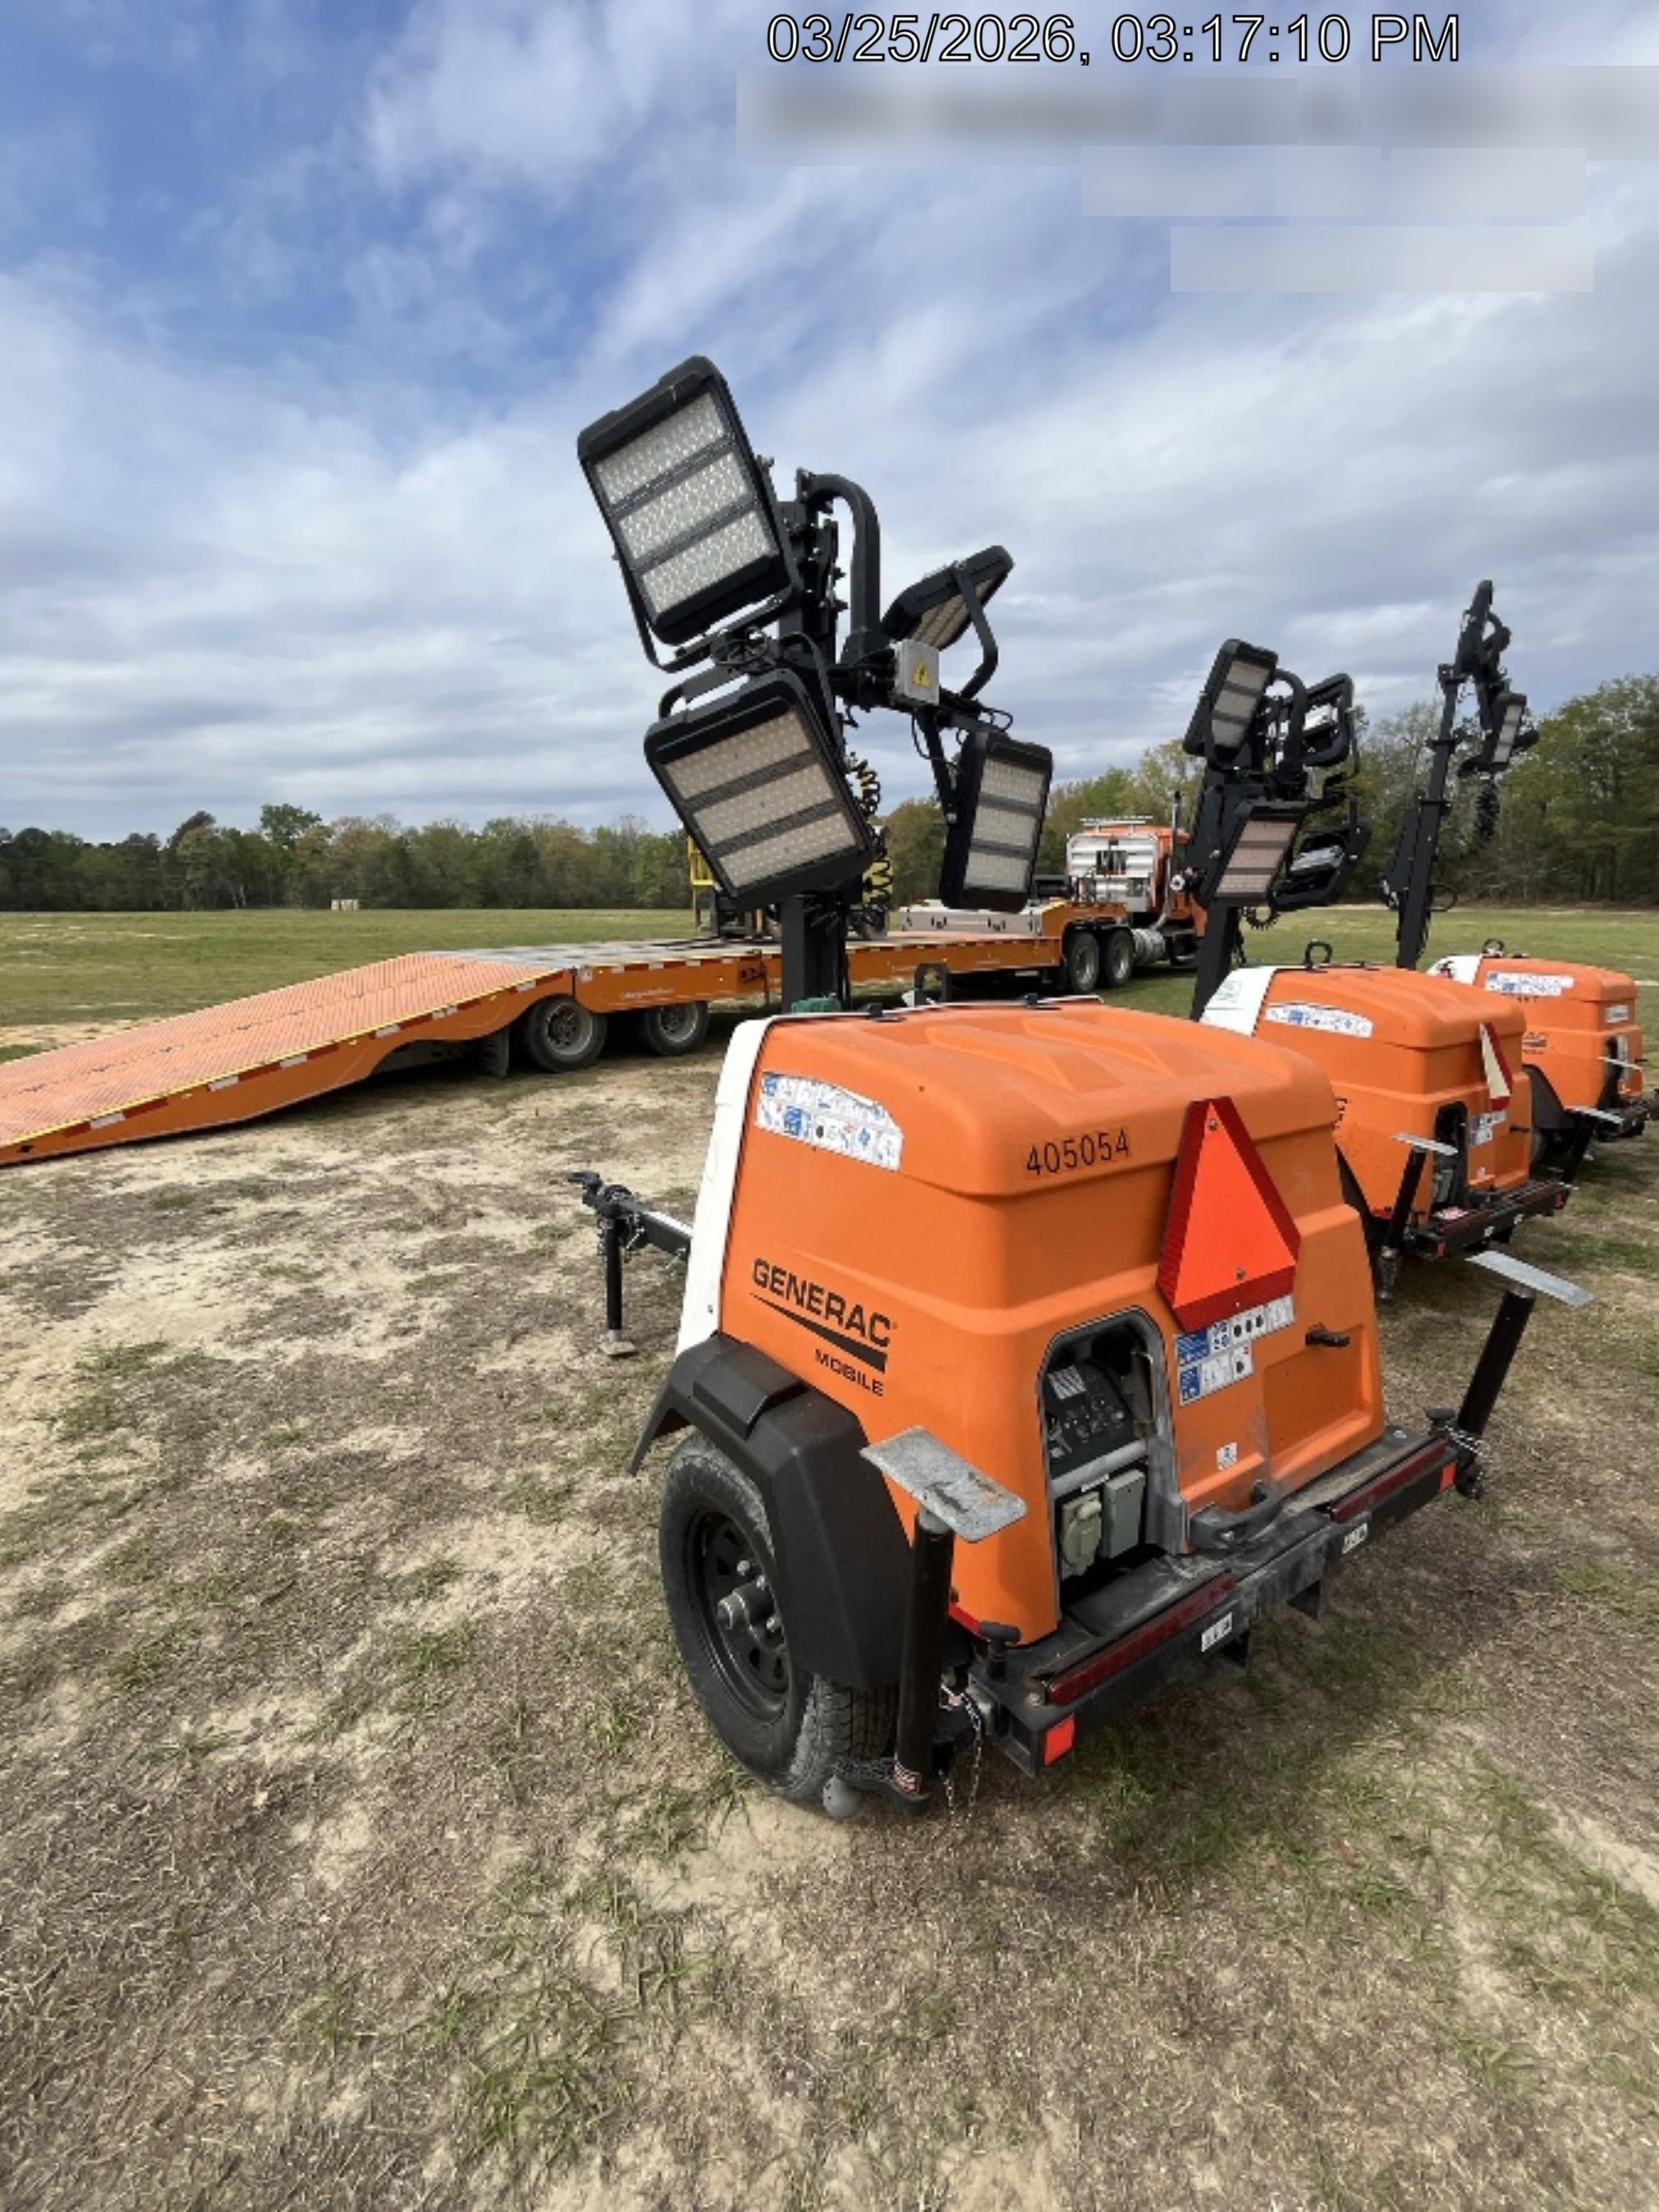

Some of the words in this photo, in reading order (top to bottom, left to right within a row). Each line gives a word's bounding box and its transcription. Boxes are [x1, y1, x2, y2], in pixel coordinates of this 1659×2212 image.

[1027, 1128, 1130, 1176] 405054
[752, 1258, 891, 1349] GENERAC
[814, 1349, 885, 1397] MOBILE
